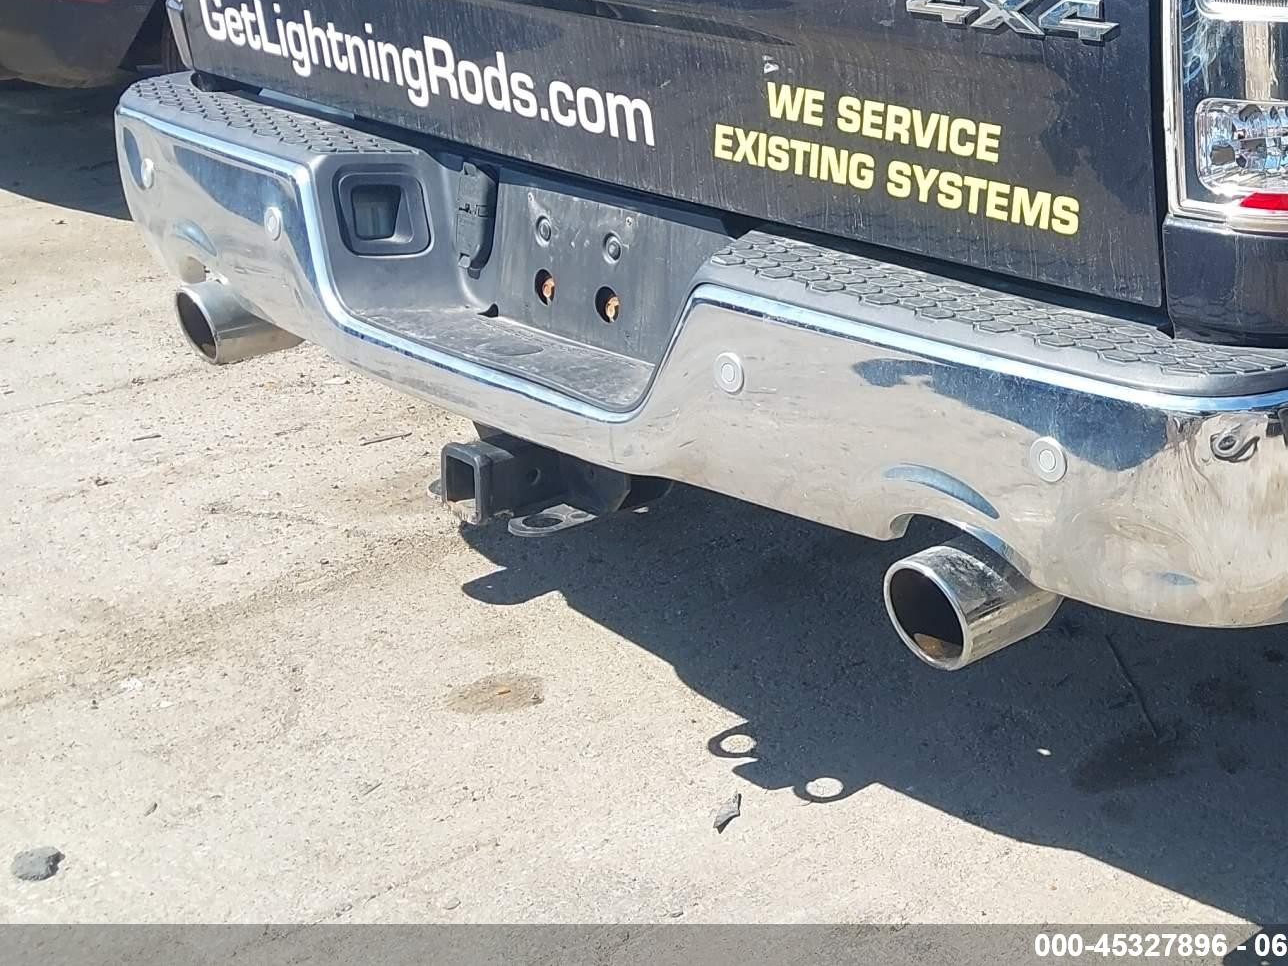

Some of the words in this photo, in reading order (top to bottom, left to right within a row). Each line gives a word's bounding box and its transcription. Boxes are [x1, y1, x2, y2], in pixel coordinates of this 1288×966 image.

[766, 81, 825, 127] WE
[836, 95, 1002, 163] SERVICE
[713, 123, 874, 191] EXISTING
[886, 160, 1081, 236] SYSTEMS
